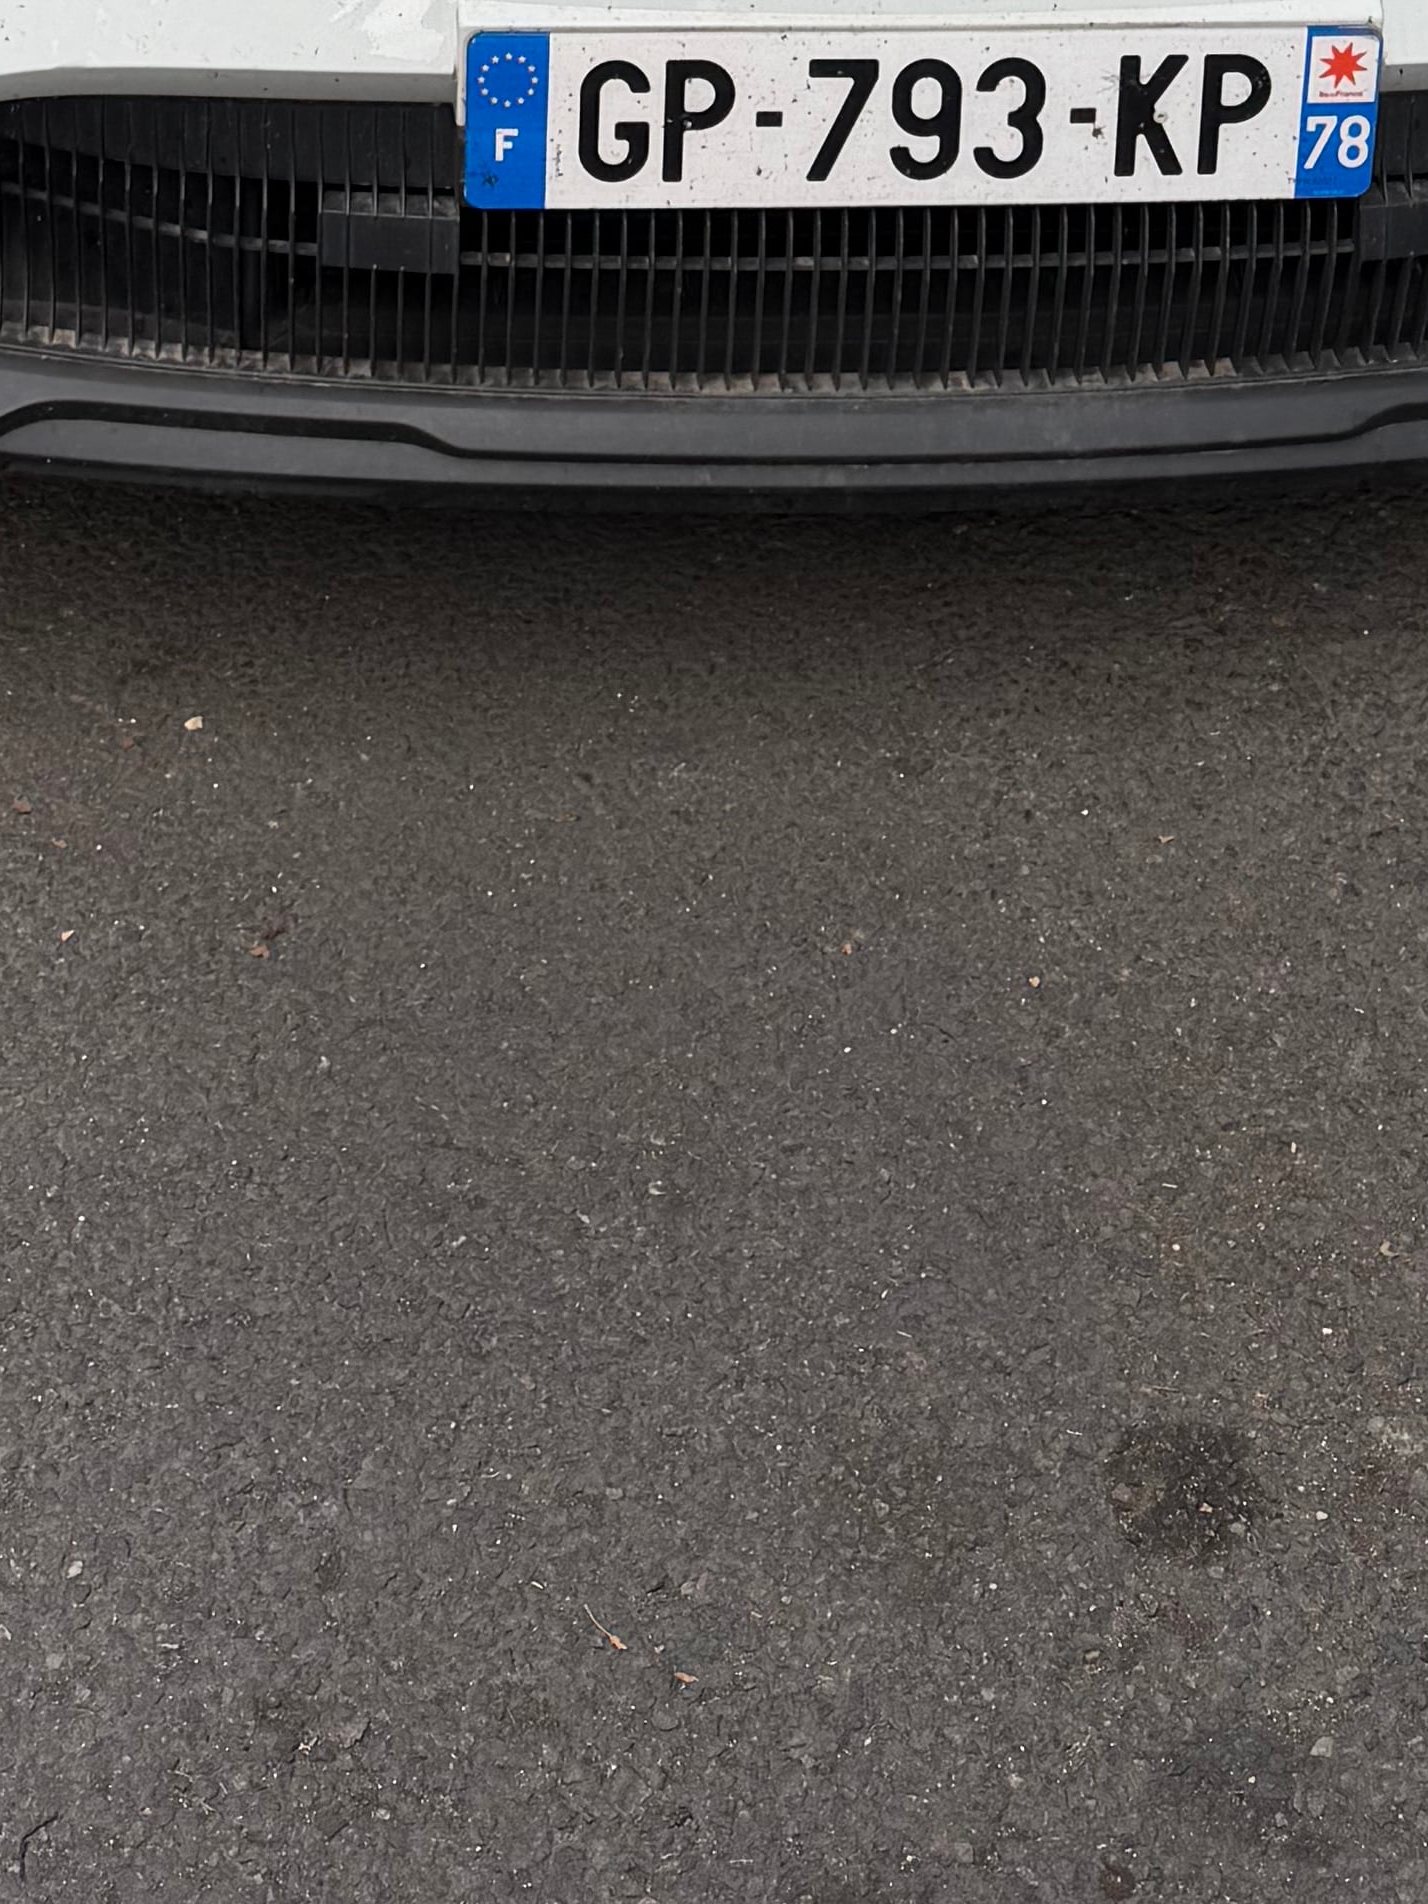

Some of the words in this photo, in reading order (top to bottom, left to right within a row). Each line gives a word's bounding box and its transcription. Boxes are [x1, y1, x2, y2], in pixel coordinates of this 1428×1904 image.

[495, 128, 519, 162] F
[578, 53, 1272, 183] GP-793-KP
[1303, 114, 1372, 170] 78
